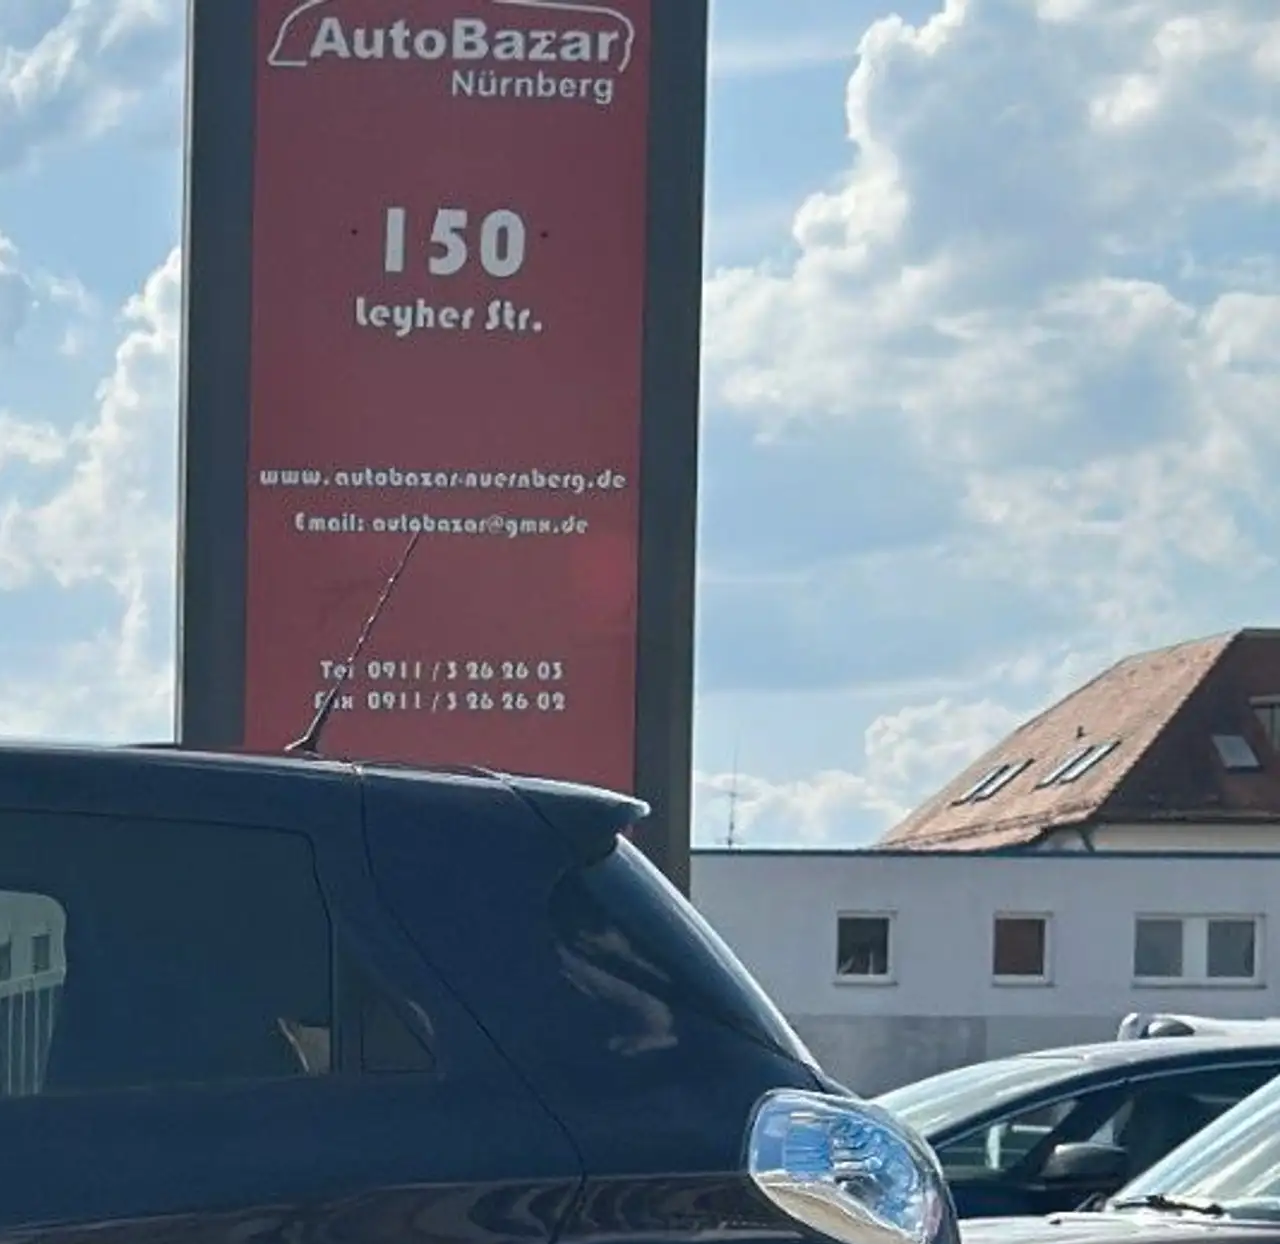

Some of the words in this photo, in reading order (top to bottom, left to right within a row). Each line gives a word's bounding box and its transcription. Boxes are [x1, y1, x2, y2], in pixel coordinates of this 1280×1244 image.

[310, 17, 619, 60] AutoBazar
[452, 69, 613, 104] Nürnberg
[385, 207, 526, 278] 150
[485, 300, 543, 331] Str.
[260, 467, 627, 494] www.autobazar-nuernberg.de
[372, 514, 589, 538] autobazar@gmx.de
